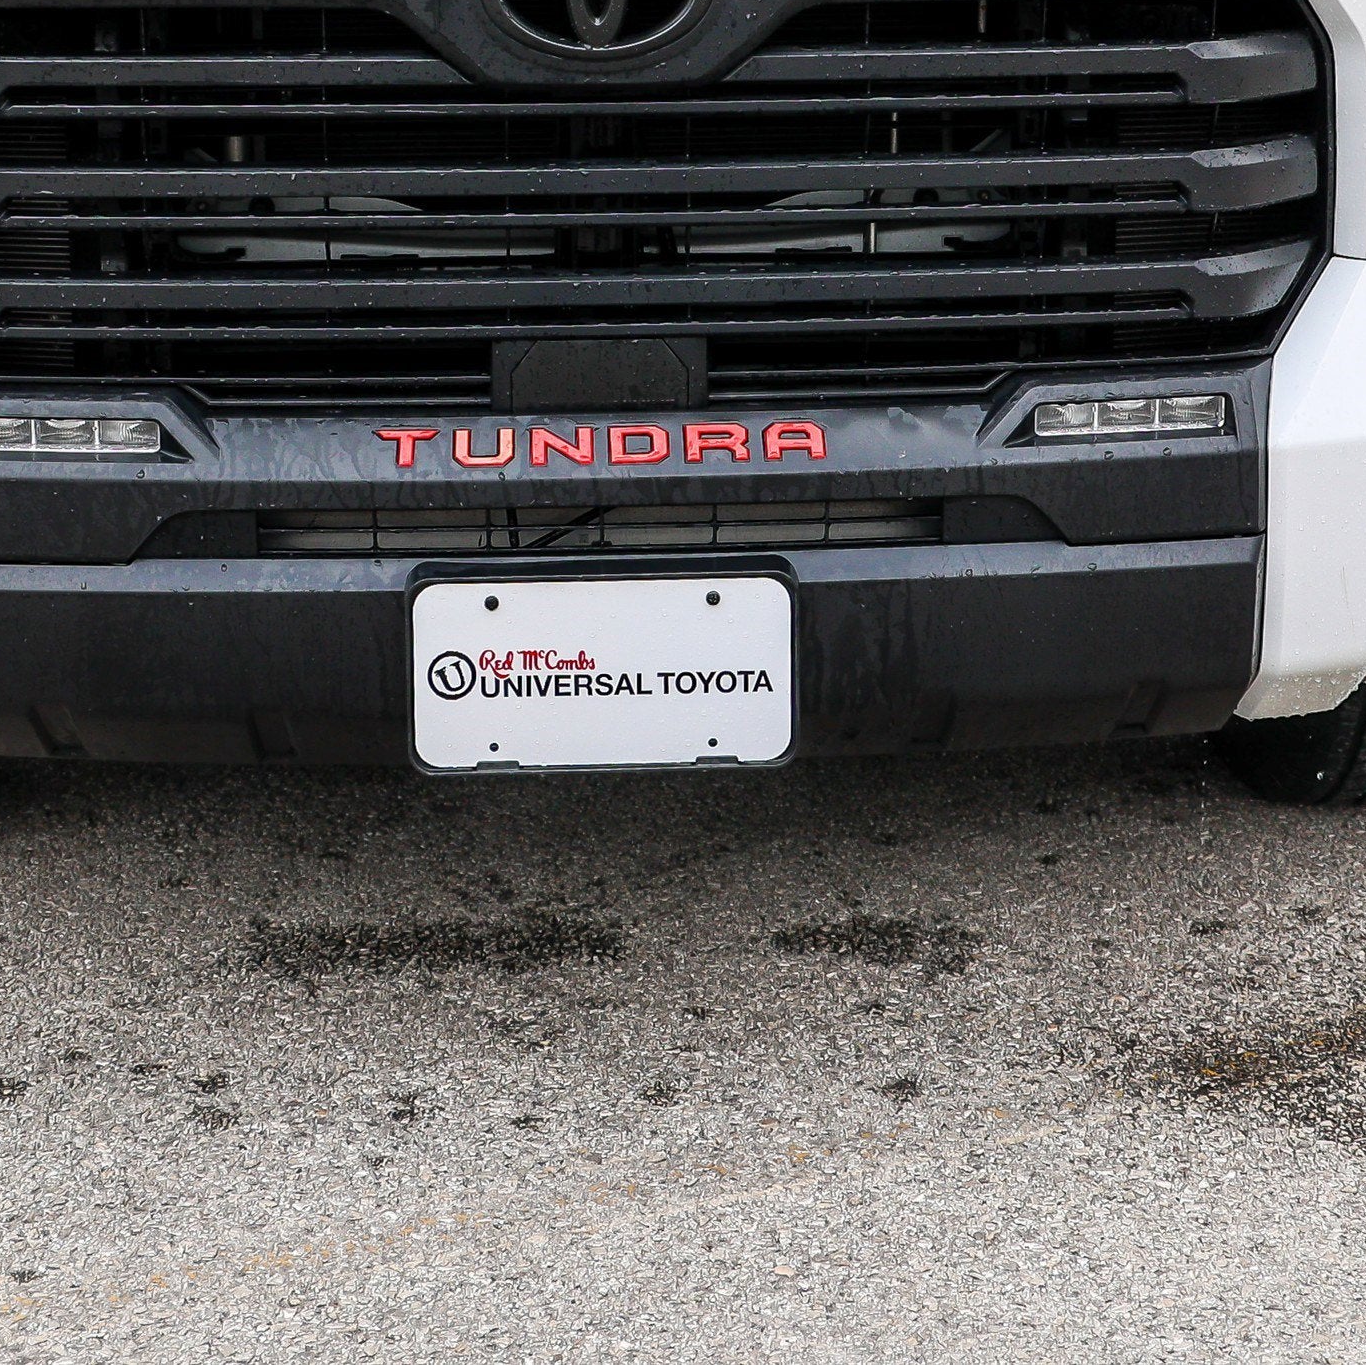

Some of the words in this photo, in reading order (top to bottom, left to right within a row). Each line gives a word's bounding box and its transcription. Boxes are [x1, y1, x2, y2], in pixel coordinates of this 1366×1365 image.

[374, 420, 828, 468] TUNDRA
[479, 649, 514, 679] Red
[517, 649, 596, 671] McCombs
[480, 672, 653, 698] UNIVERSAL
[657, 670, 774, 695] TOYOTA
